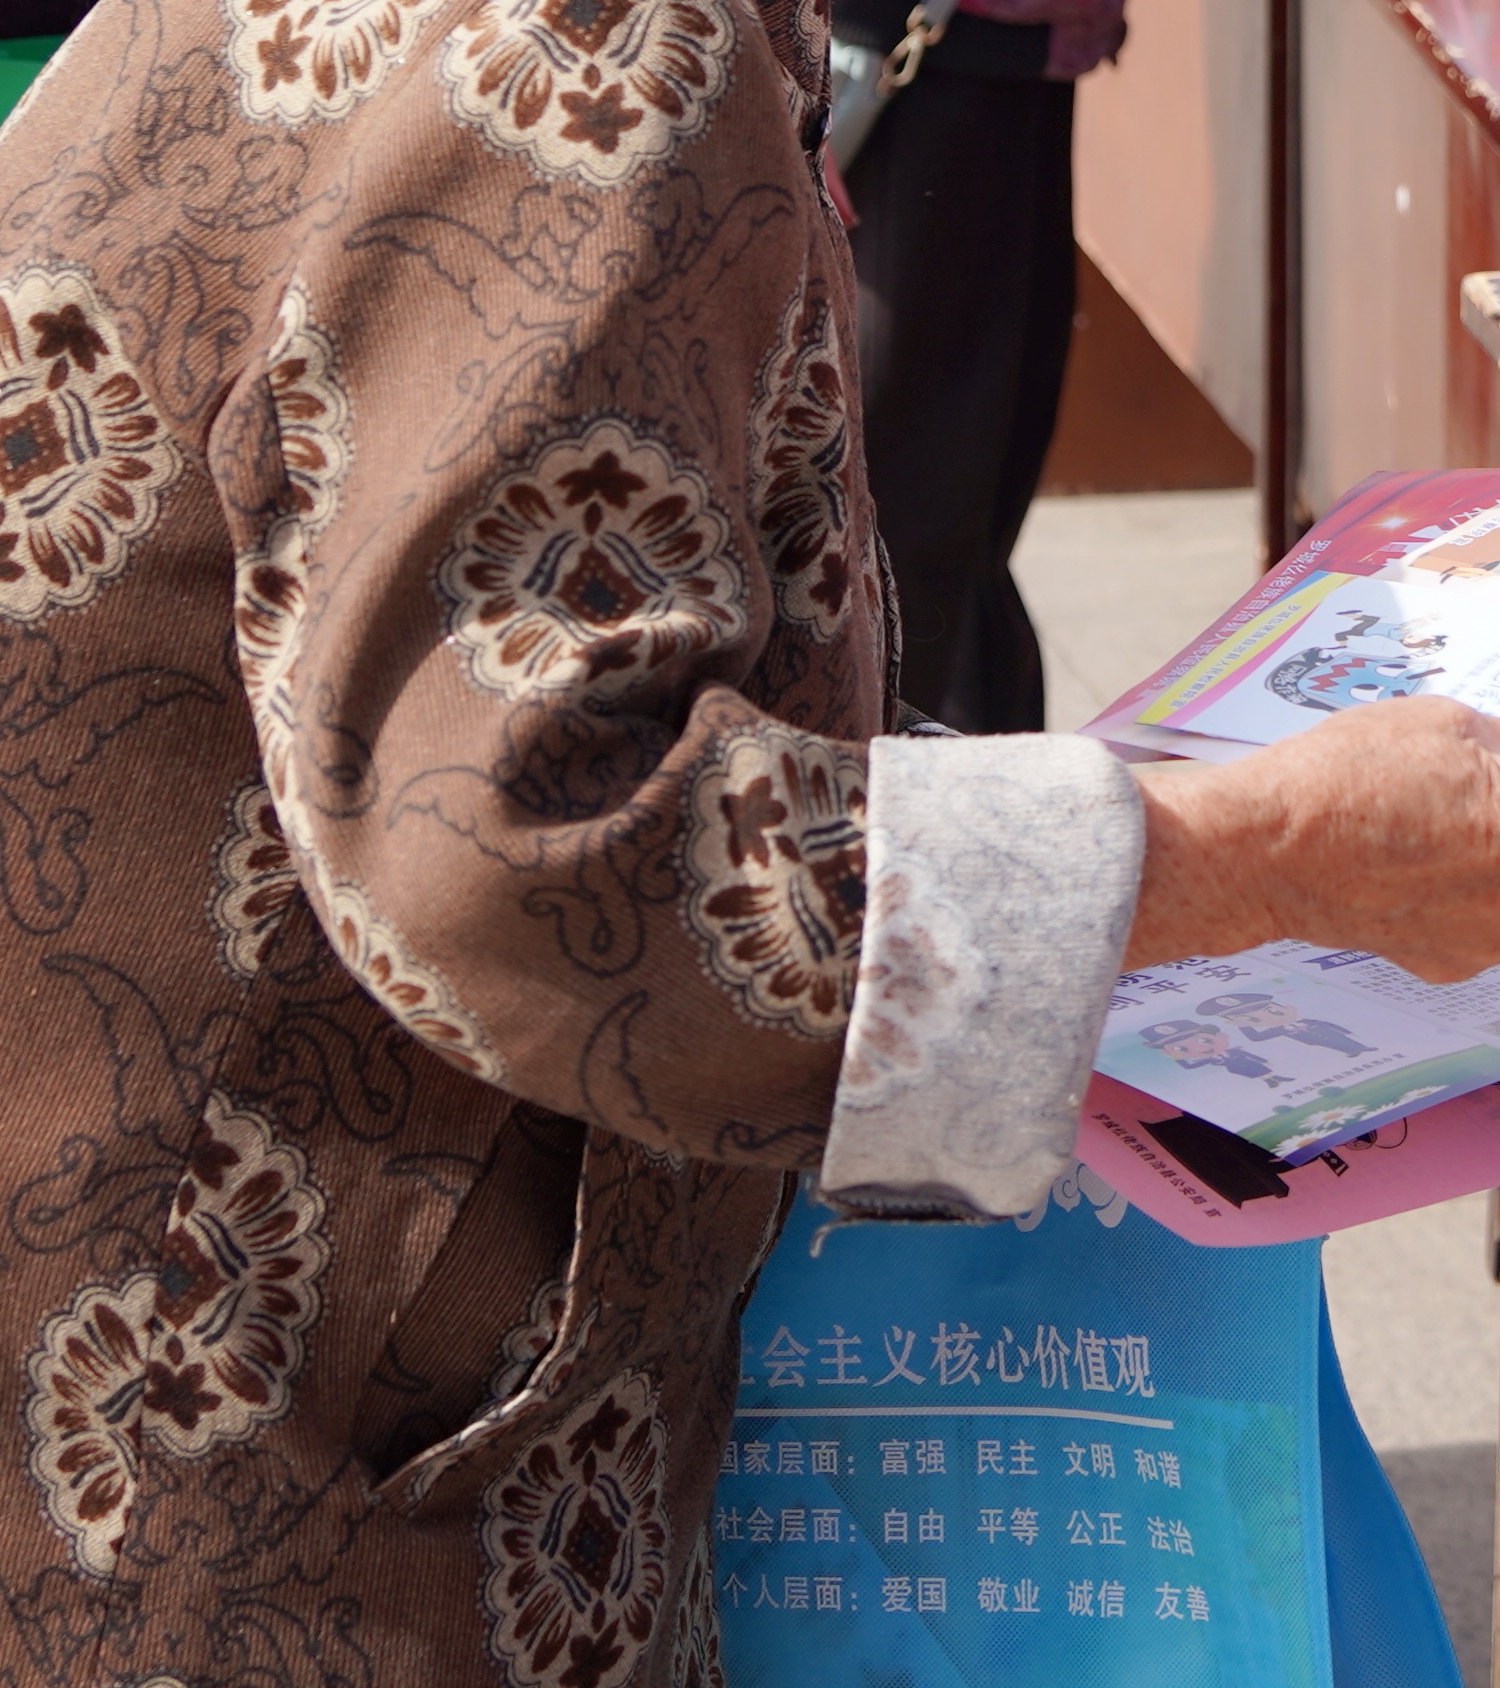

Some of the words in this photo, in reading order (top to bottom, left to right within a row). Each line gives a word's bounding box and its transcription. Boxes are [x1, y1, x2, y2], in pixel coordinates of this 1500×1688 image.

[1091, 1113, 1206, 1206] 罗城仫佬族自治县公安局
[880, 1440, 947, 1476] 富强
[978, 1441, 1039, 1476] 民主
[1064, 1442, 1118, 1478] 文明
[1136, 1448, 1182, 1490] 和谐
[882, 1508, 945, 1544] 自由
[978, 1508, 1040, 1546] 平等
[1067, 1510, 1126, 1546] 公正
[1148, 1516, 1196, 1557] 法治
[881, 1576, 947, 1613] 爱国
[978, 1578, 1041, 1614] 敬业
[1067, 1581, 1126, 1618] 诚信
[1155, 1583, 1211, 1623] 友善
